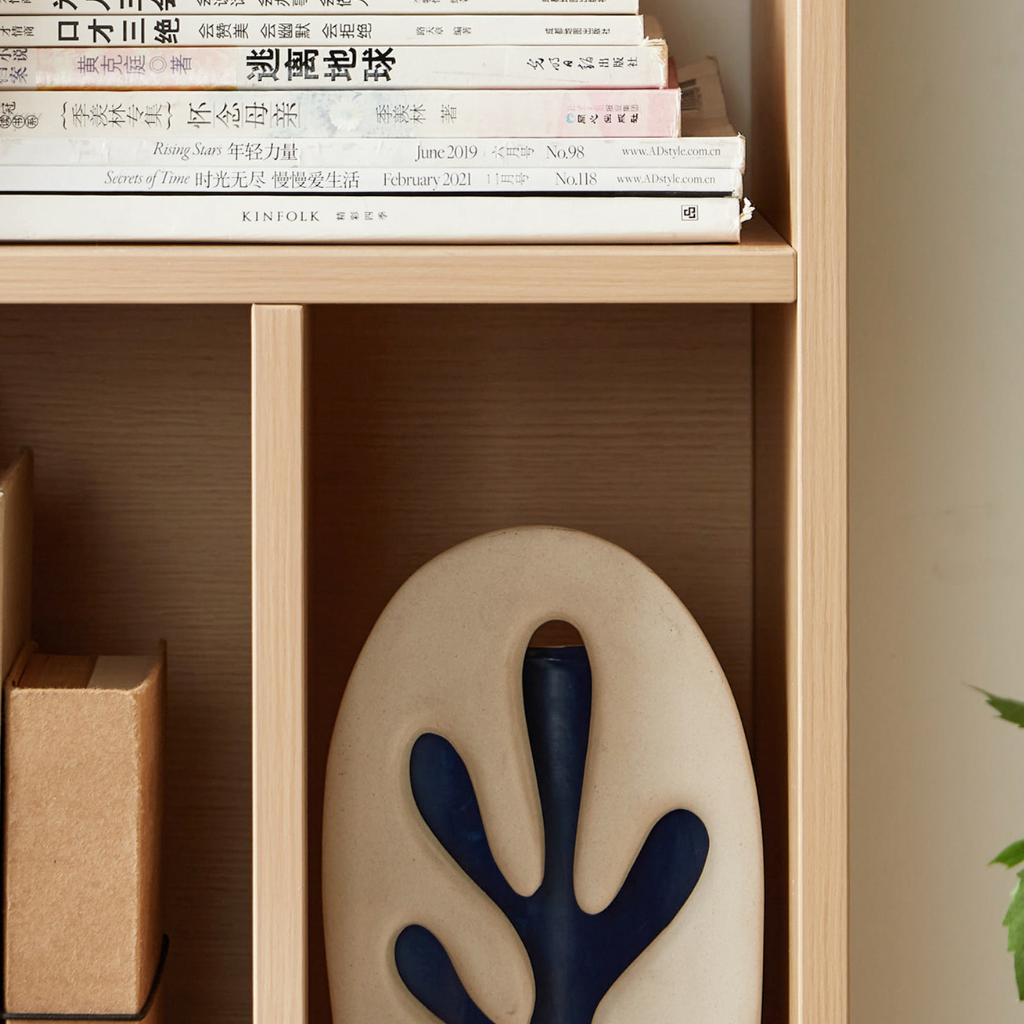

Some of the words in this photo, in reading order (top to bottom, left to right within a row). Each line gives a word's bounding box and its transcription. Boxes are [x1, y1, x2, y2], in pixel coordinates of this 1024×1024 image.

[58, 18, 180, 44] 口才三绝
[198, 23, 249, 38] 会赞美
[260, 23, 311, 38] 会幽默
[322, 23, 372, 38] 会拒绝
[246, 48, 396, 82] 逃离地球
[187, 102, 299, 128] 怀念母亲
[376, 104, 426, 124] 季羡林
[441, 104, 457, 124] 著
[153, 142, 191, 161] Rising
[193, 142, 222, 156] Stars
[227, 142, 298, 161] 年轻力量
[415, 145, 445, 162] June
[447, 145, 478, 159] 2019
[492, 146, 534, 159] 六月号
[546, 144, 585, 159] No.98
[622, 145, 722, 159] www.ADstyle.com.cn
[104, 171, 143, 184] Secrets
[144, 170, 158, 189] of
[160, 170, 190, 184] Time
[195, 171, 266, 189] 时光无尽
[272, 171, 360, 189] 慢慢爱生活
[383, 172, 441, 191] February
[443, 172, 472, 186] 2021
[556, 172, 598, 186] No.118
[616, 173, 716, 186] www.ADstyle.com.cn
[242, 211, 320, 222] KINFOLK
